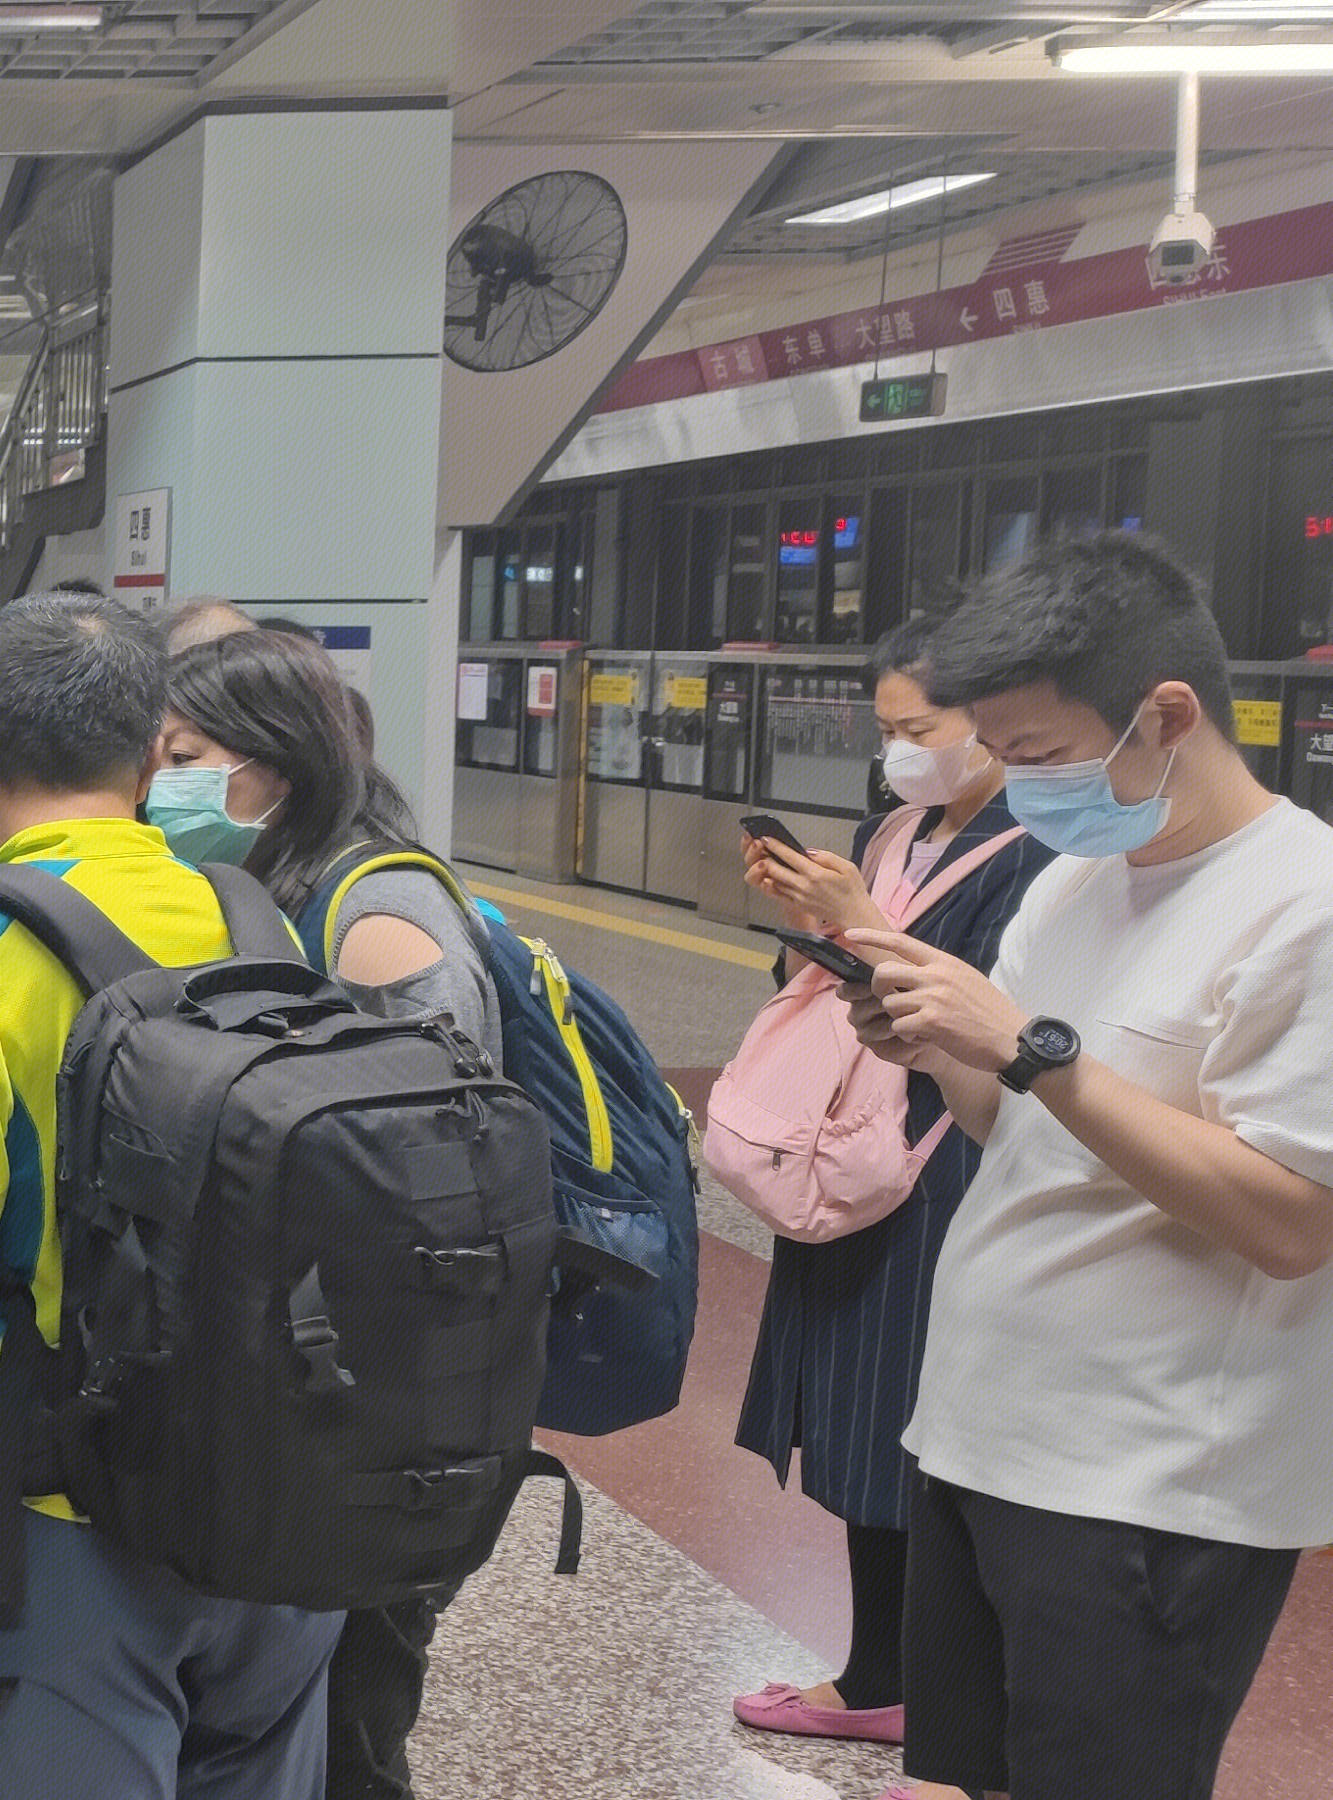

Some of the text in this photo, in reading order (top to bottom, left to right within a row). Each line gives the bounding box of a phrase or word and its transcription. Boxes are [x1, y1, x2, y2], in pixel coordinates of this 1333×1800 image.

[993, 279, 1050, 321] 四惠
[782, 328, 827, 365] 东单
[855, 309, 916, 350] 大望路
[709, 345, 754, 380] 古城
